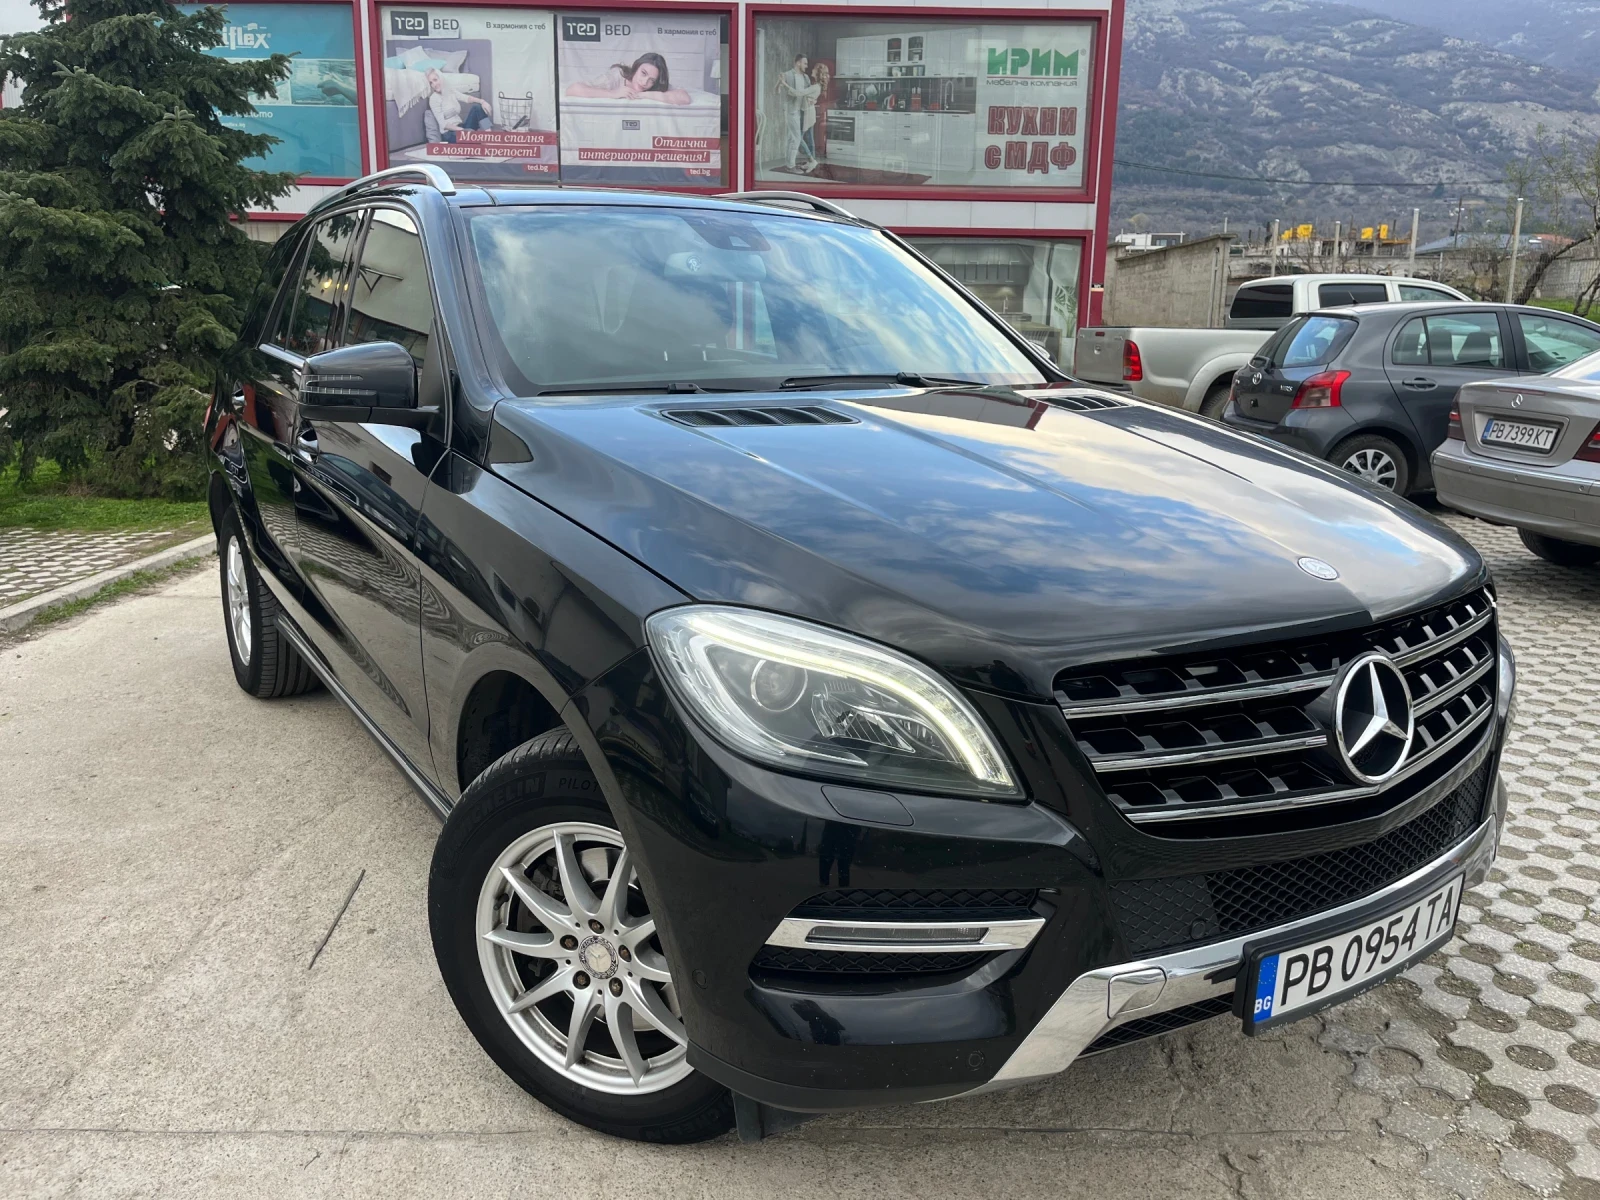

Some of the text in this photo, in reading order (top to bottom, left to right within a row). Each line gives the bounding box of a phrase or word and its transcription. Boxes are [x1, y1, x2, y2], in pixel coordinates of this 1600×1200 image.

[433, 19, 460, 30] BED
[493, 23, 528, 31] хармония
[605, 25, 631, 36] BED
[221, 26, 270, 51] iflex
[987, 48, 1079, 76] ИРИМ
[988, 106, 1077, 135] КУХНИ
[459, 131, 544, 143] Моята спалня
[654, 136, 707, 148] Отлични
[433, 146, 537, 157] е моята крепост!
[580, 151, 707, 162] интериорни решения!
[1004, 141, 1076, 174] МДФ
[527, 164, 549, 172] ted.bg
[1280, 884, 1454, 1007] PB 0954 TA
[1254, 996, 1271, 1014] BG
